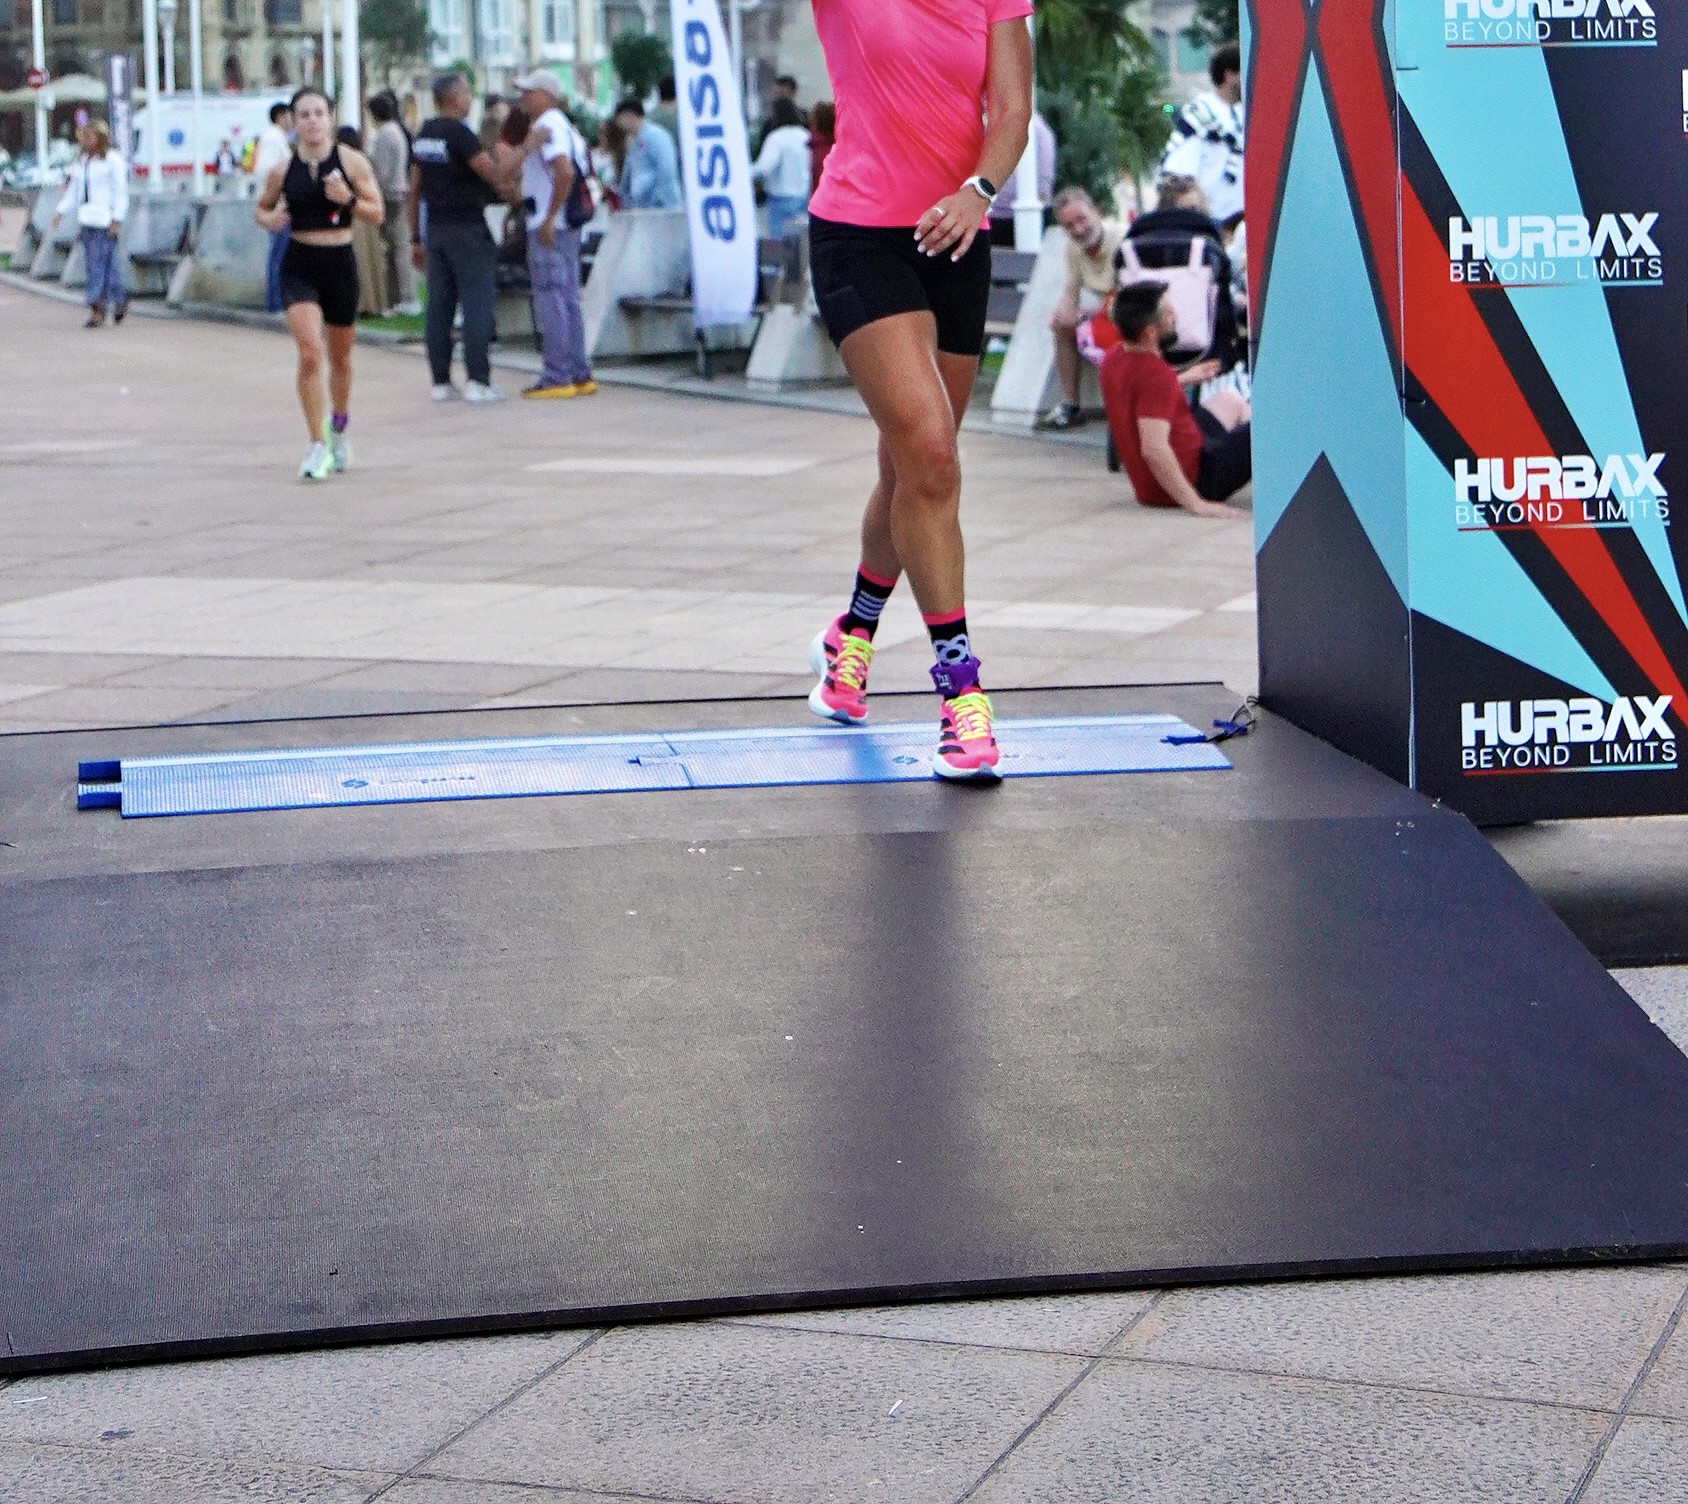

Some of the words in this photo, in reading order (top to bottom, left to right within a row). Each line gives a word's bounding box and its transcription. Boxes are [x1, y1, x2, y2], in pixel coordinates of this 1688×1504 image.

[1444, 19, 1552, 42] BEYOND
[1570, 18, 1658, 41] LIMITS
[683, 19, 737, 243] asisa
[1448, 213, 1661, 261] HURBAX
[1449, 260, 1557, 283] BEYOND
[1575, 258, 1663, 280] LIMITS
[1454, 452, 1669, 503] HURBAX
[1455, 502, 1564, 525] BEYOND
[1582, 498, 1671, 522] LIMITS
[1460, 695, 1676, 747] HURBAX
[1462, 745, 1570, 770] BEYOND
[1589, 741, 1678, 765] LIMITS
